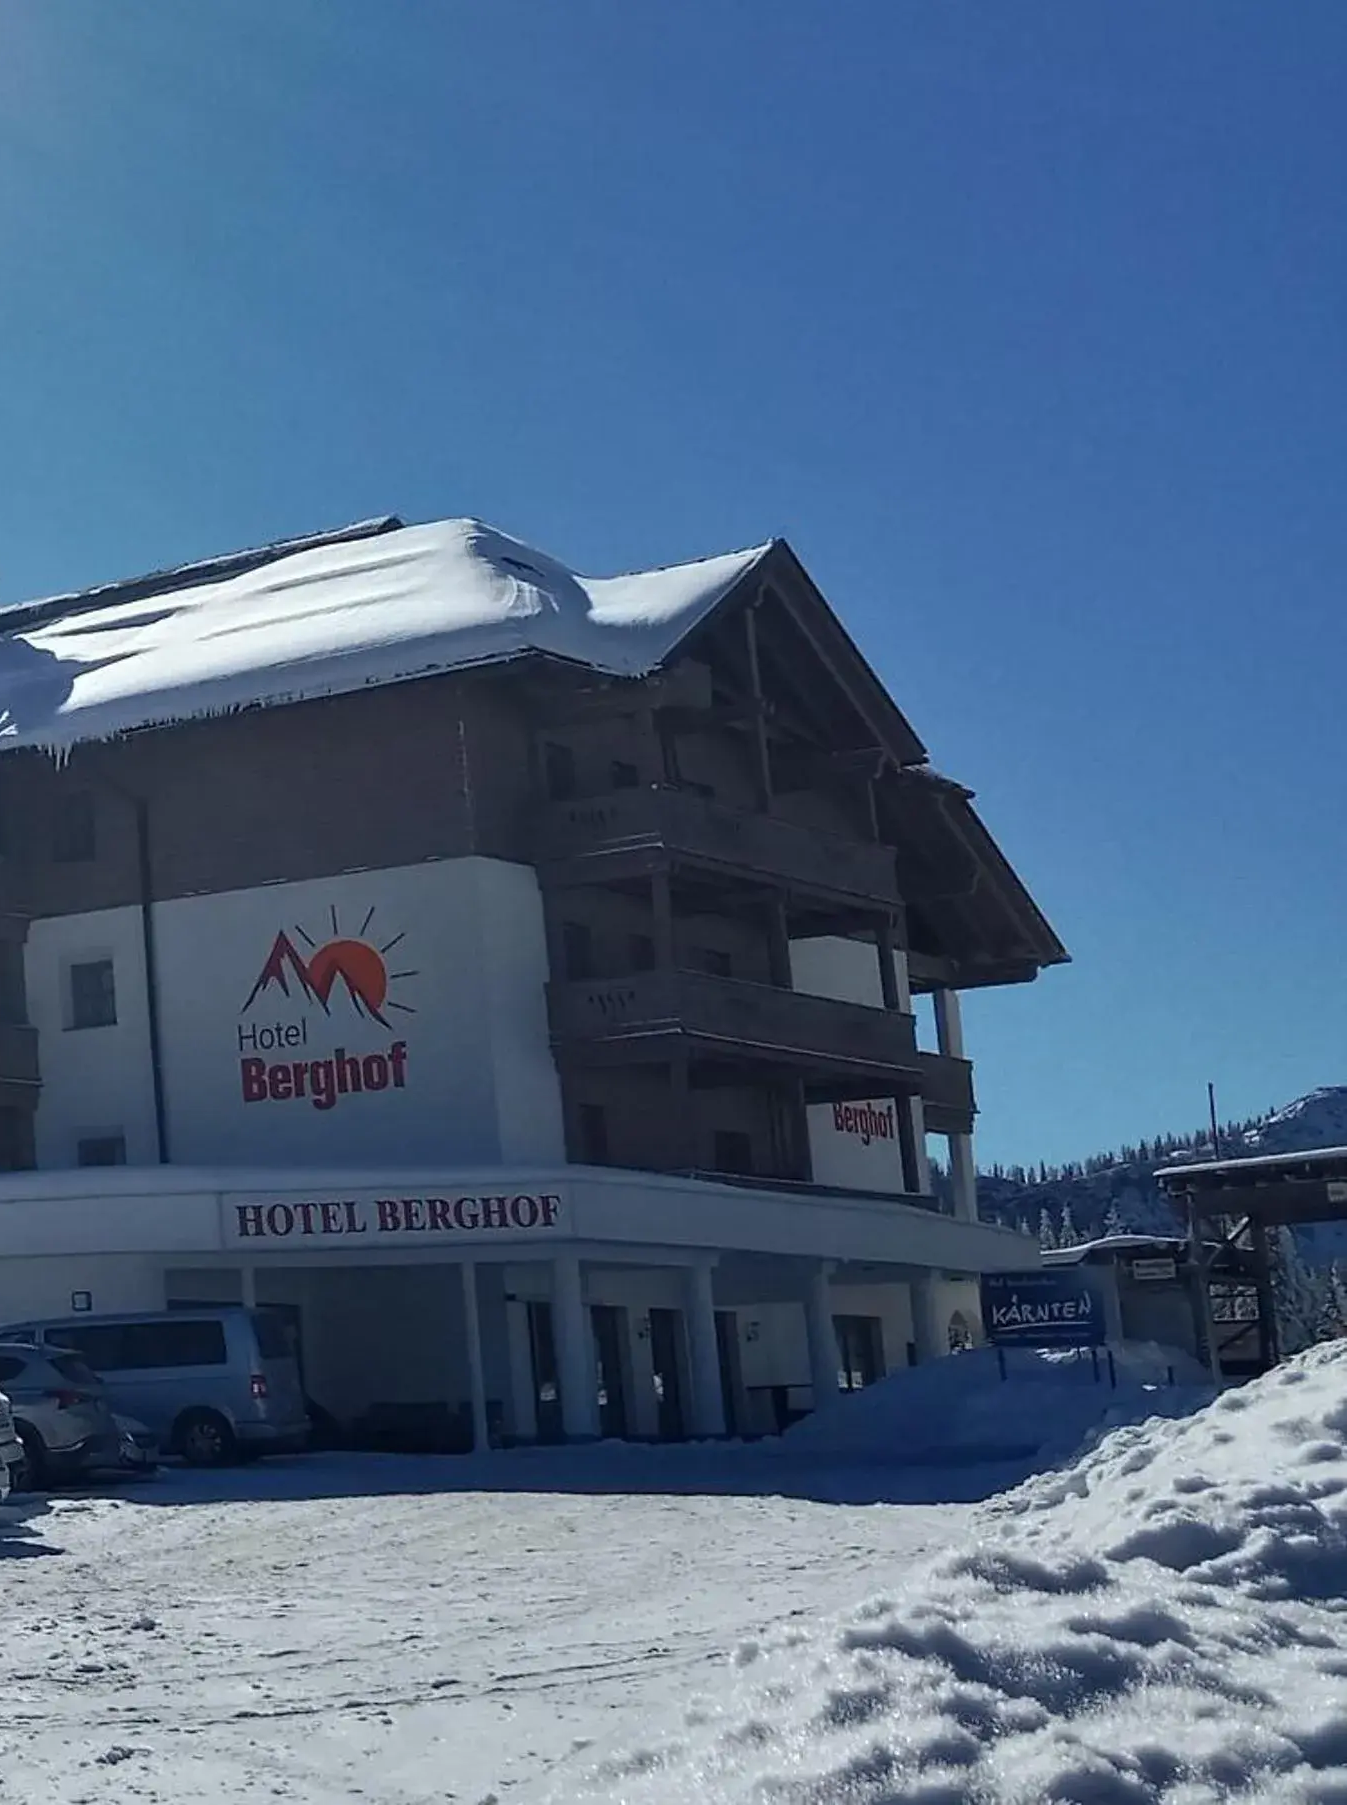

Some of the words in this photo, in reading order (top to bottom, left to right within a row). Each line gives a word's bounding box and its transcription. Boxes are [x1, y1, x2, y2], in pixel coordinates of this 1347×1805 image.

[238, 1017, 307, 1051] Hotel
[240, 1040, 407, 1111] Berghof
[832, 1101, 895, 1146] Berghof
[235, 1201, 367, 1237] HOTEL
[374, 1195, 562, 1232] BERGHOF
